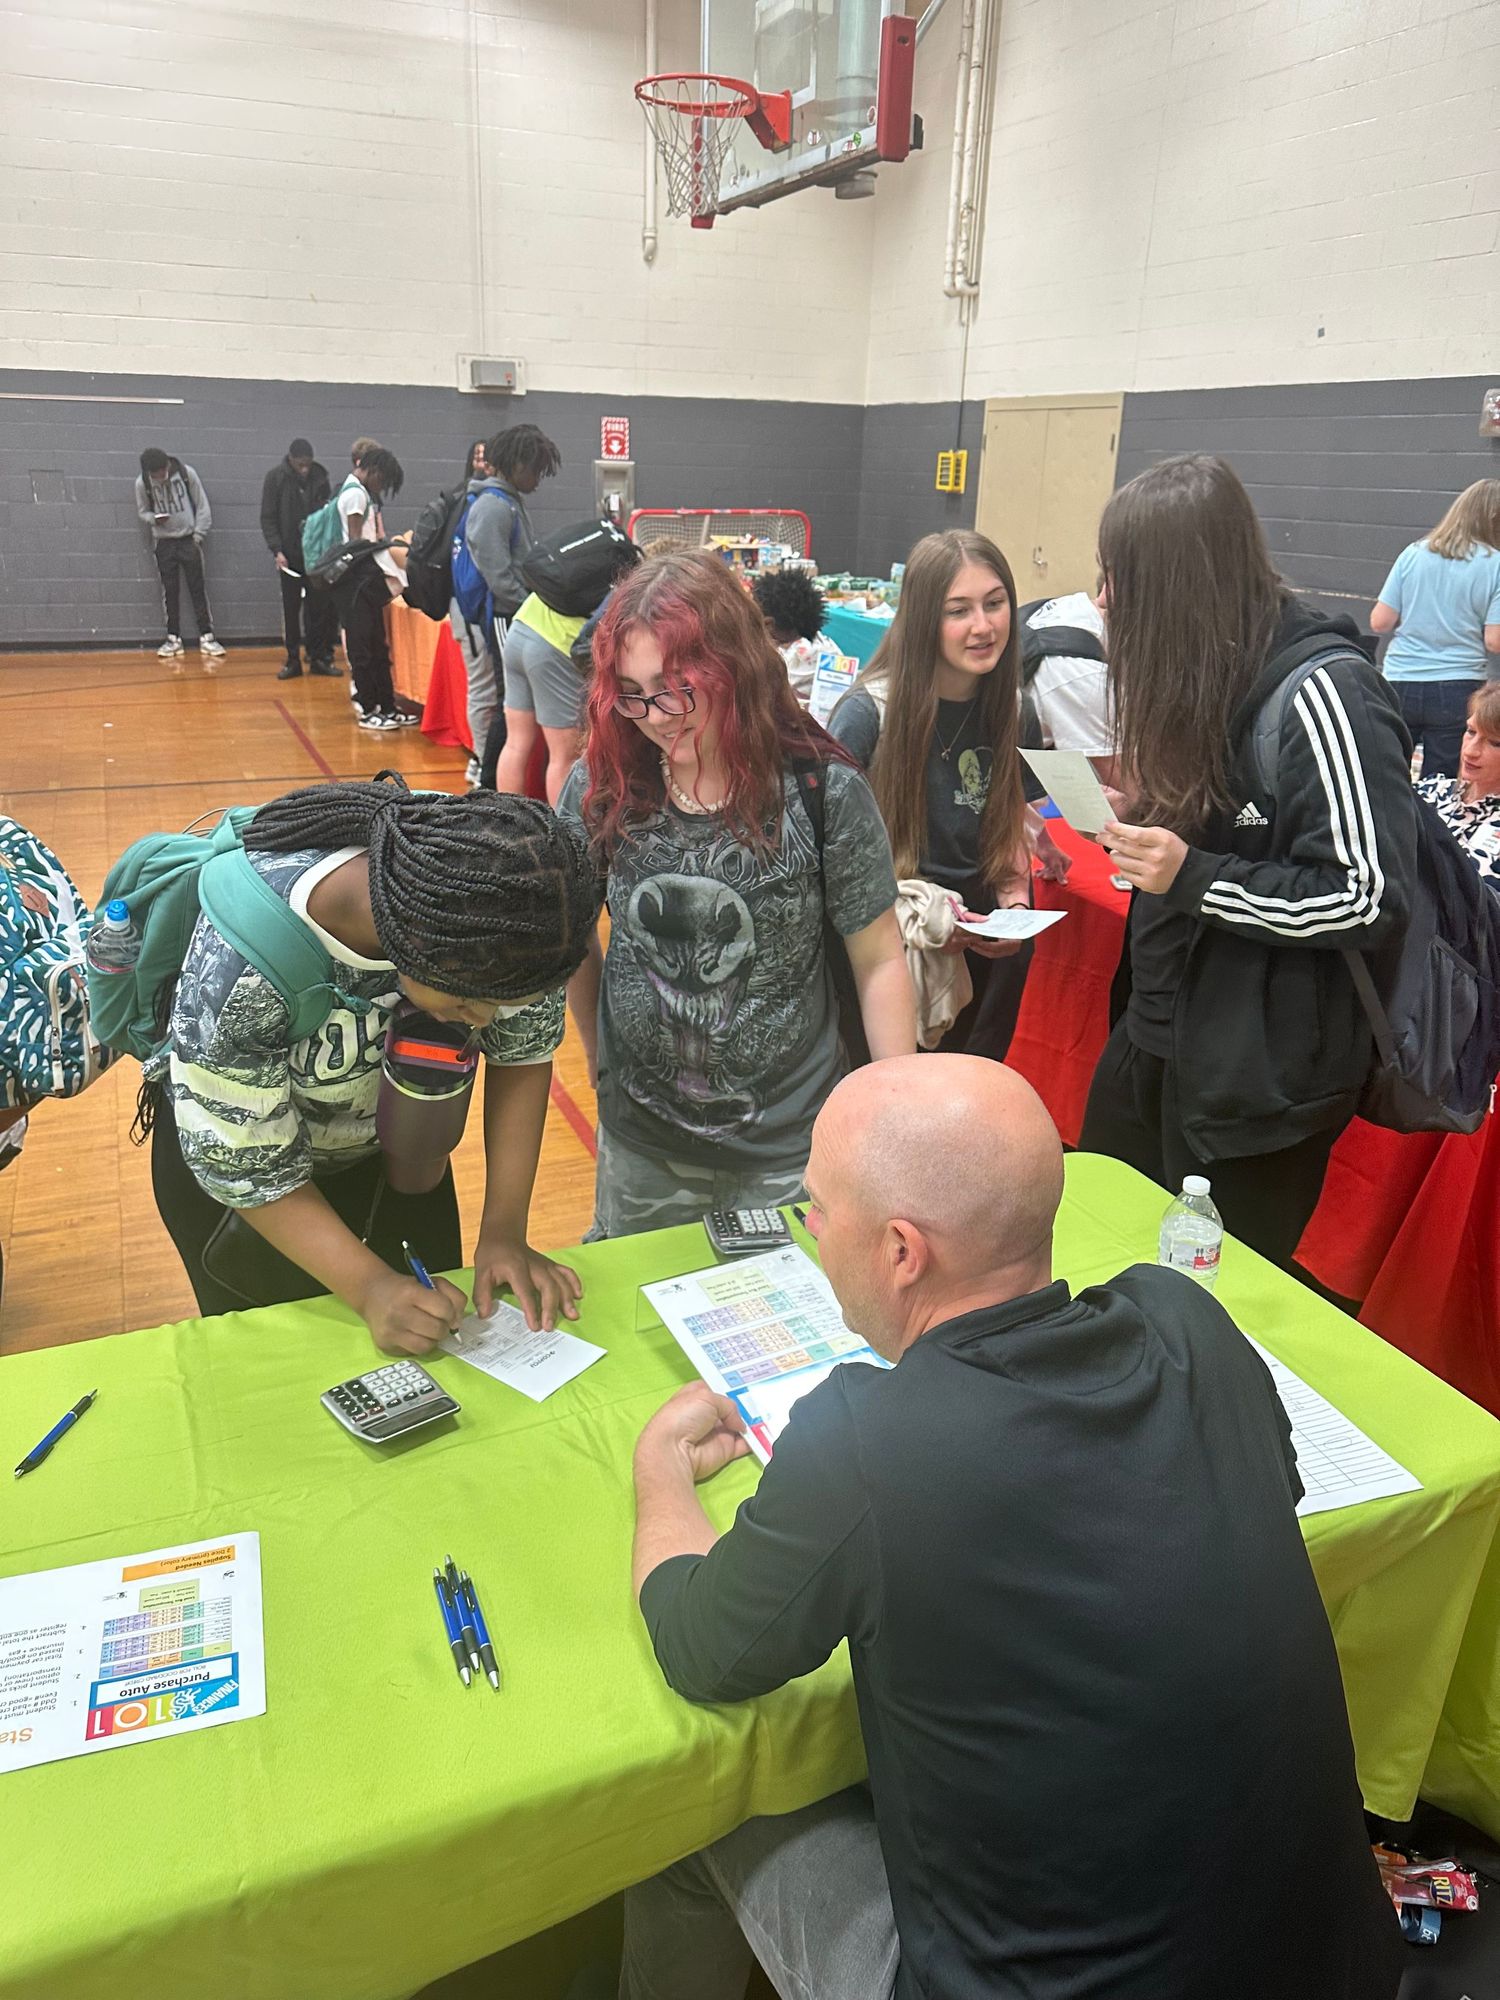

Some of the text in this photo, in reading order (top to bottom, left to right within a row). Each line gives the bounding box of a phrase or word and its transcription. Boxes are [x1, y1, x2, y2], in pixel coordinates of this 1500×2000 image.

[153, 479, 185, 514] GAP
[182, 1552, 210, 1562] (primary
[176, 1555, 231, 1570] Supplies Needed
[40, 1624, 67, 1632] register
[36, 1630, 66, 1639] Subtract
[2, 1638, 19, 1646] total
[30, 1642, 64, 1652] insurance
[39, 1647, 63, 1656] (based
[5, 1666, 60, 1681] transportation)
[36, 1672, 60, 1680] option
[9, 1683, 28, 1691] picks
[30, 1678, 59, 1687] Student
[120, 1672, 210, 1697] Purchase Auto
[41, 1698, 56, 1706] Odd
[26, 1704, 55, 1714] Student
[93, 1680, 239, 1734] FINANCES 101
[5, 1712, 23, 1720] must
[1432, 1876, 1454, 1906] RITZ
